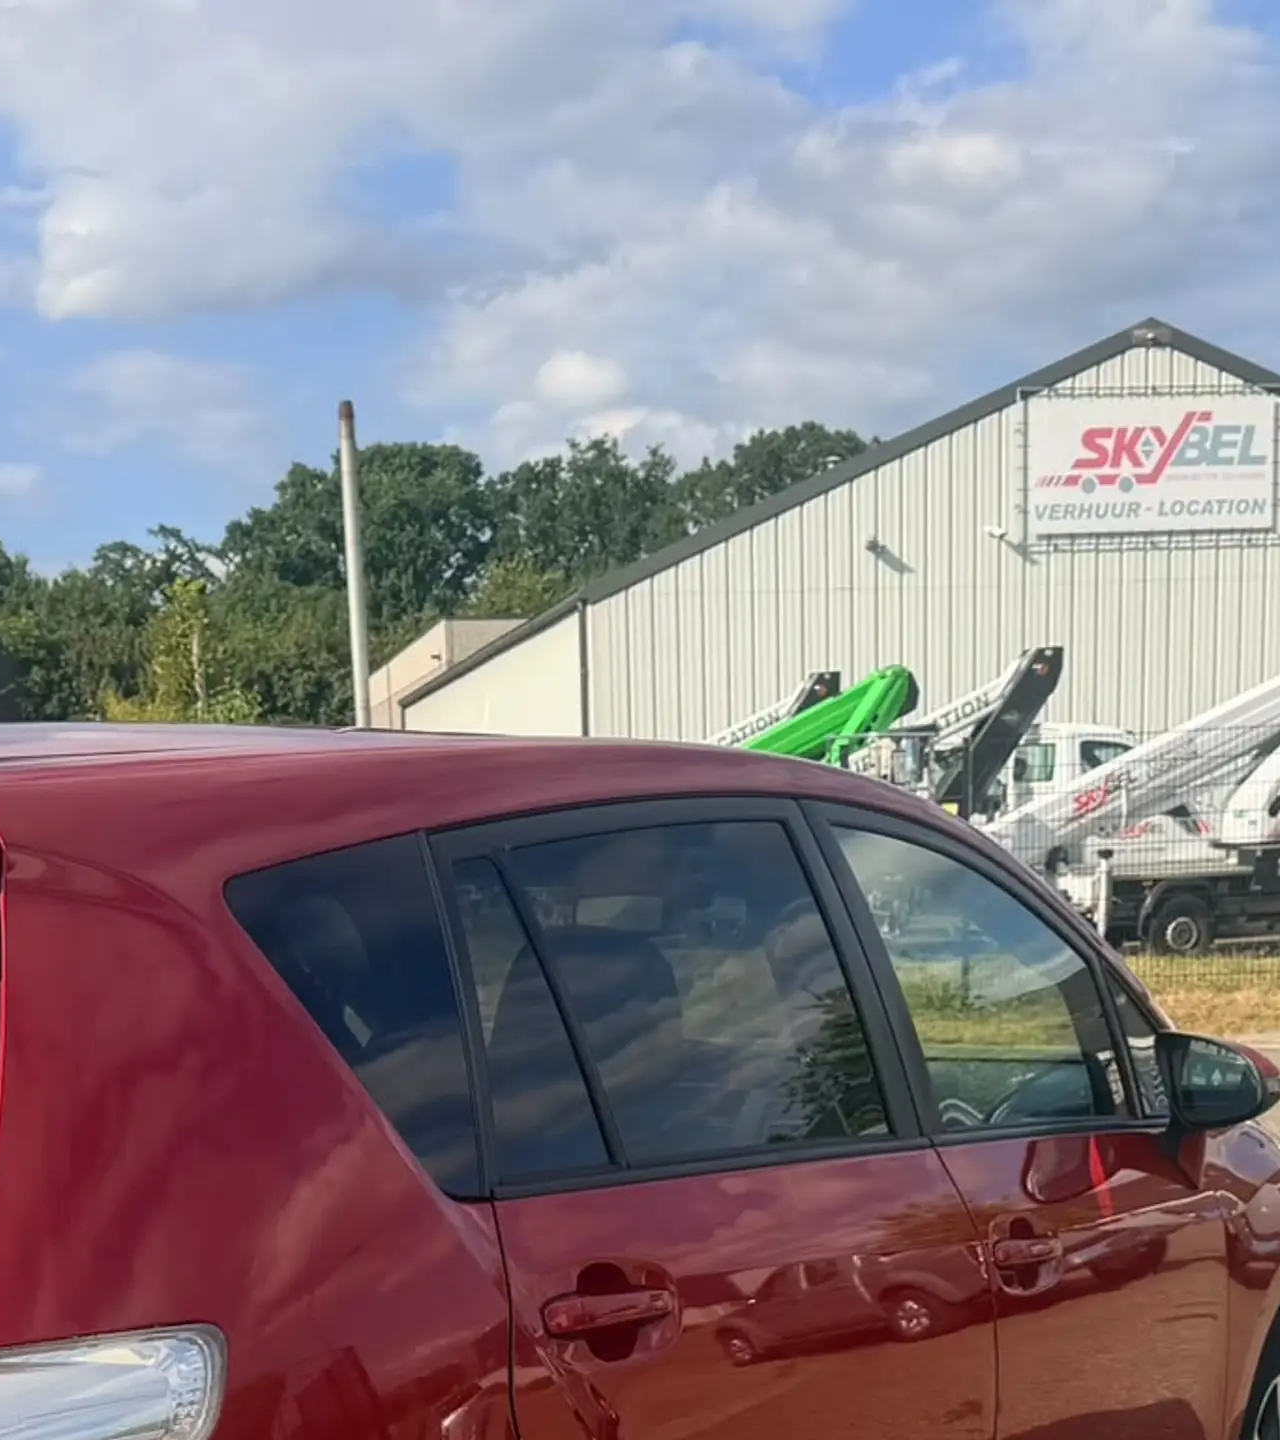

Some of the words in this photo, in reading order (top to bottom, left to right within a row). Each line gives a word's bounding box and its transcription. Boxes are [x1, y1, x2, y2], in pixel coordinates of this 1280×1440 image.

[1066, 411, 1267, 483] SKYBEL
[1035, 501, 1142, 521] VERHUUR
[1157, 498, 1267, 517] LOCATION
